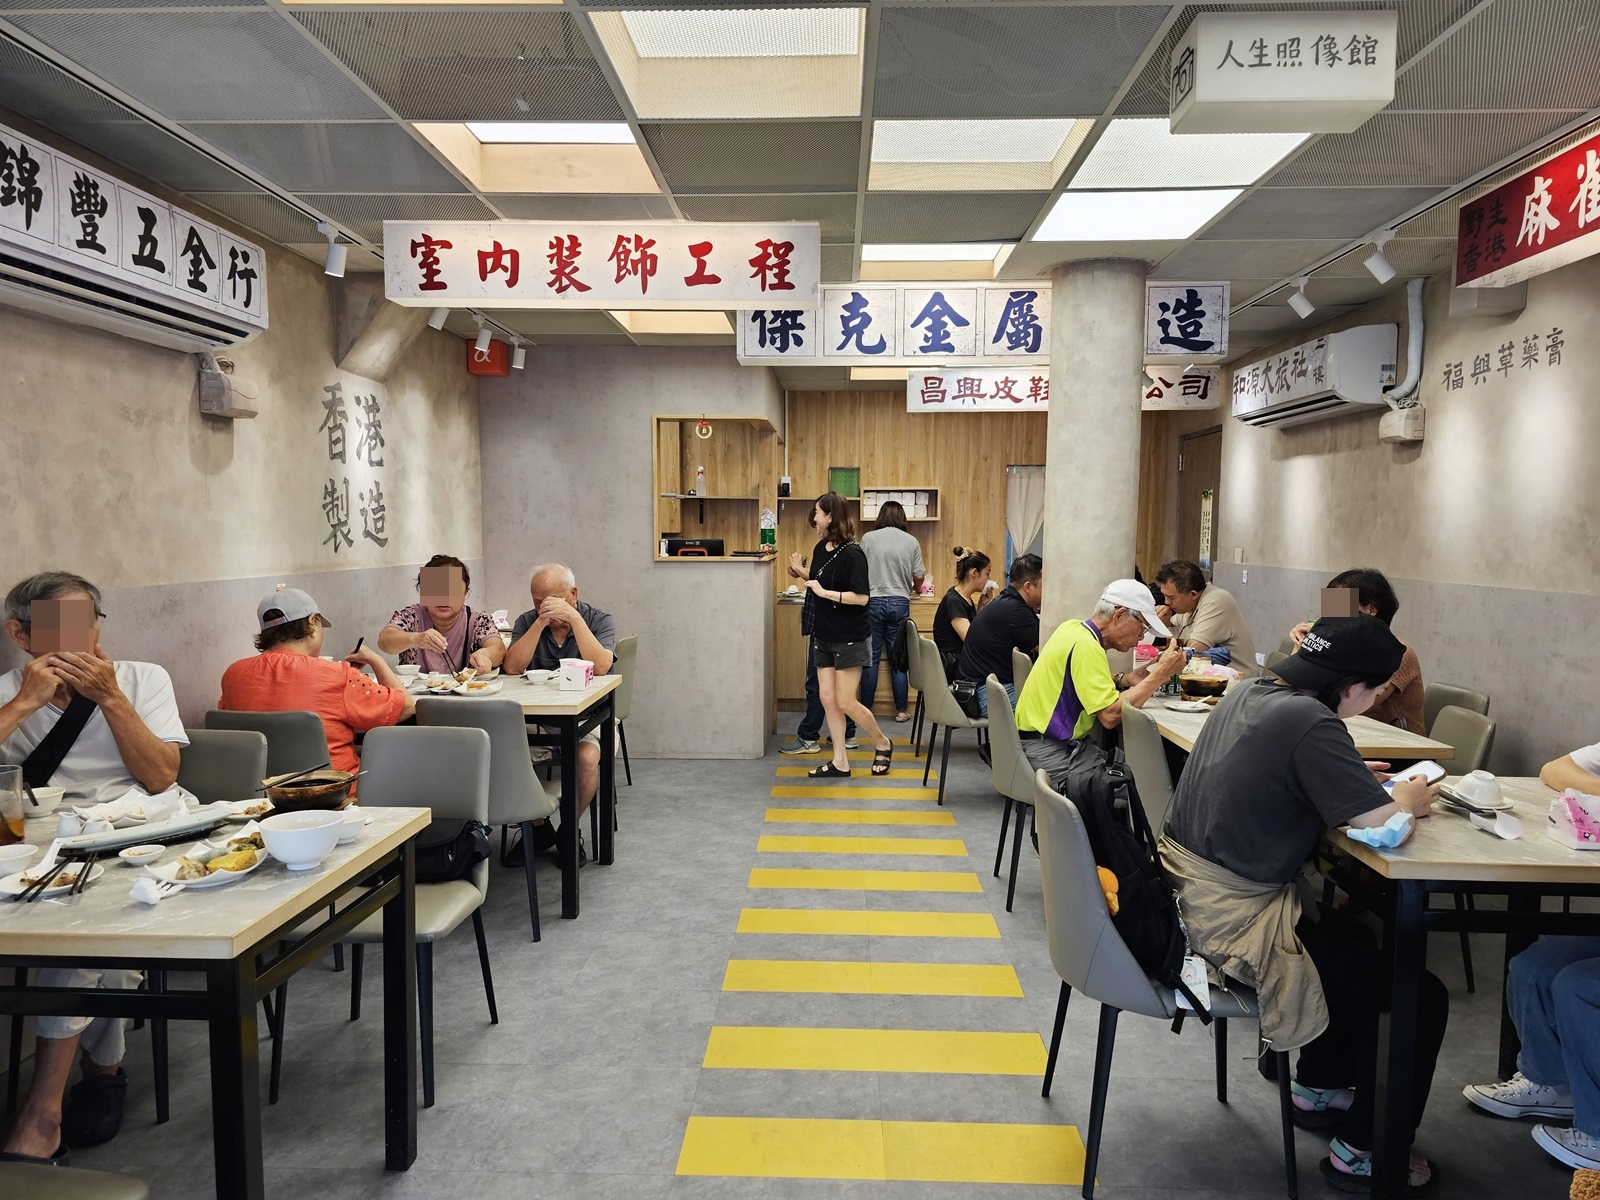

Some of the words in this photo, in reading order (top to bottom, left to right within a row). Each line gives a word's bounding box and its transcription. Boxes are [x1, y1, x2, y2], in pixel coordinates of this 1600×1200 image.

[1217, 33, 1380, 69] 人生照像館
[0, 140, 258, 309] 錦豐五金行
[1464, 195, 1508, 239] 野生
[1515, 149, 1600, 247] 麻雀
[1462, 233, 1508, 275] 香港
[751, 288, 1215, 354] 傑克金屬造
[1441, 327, 1564, 392] 福興草藥膏
[319, 382, 385, 467] 香港
[322, 477, 388, 553] 製造
